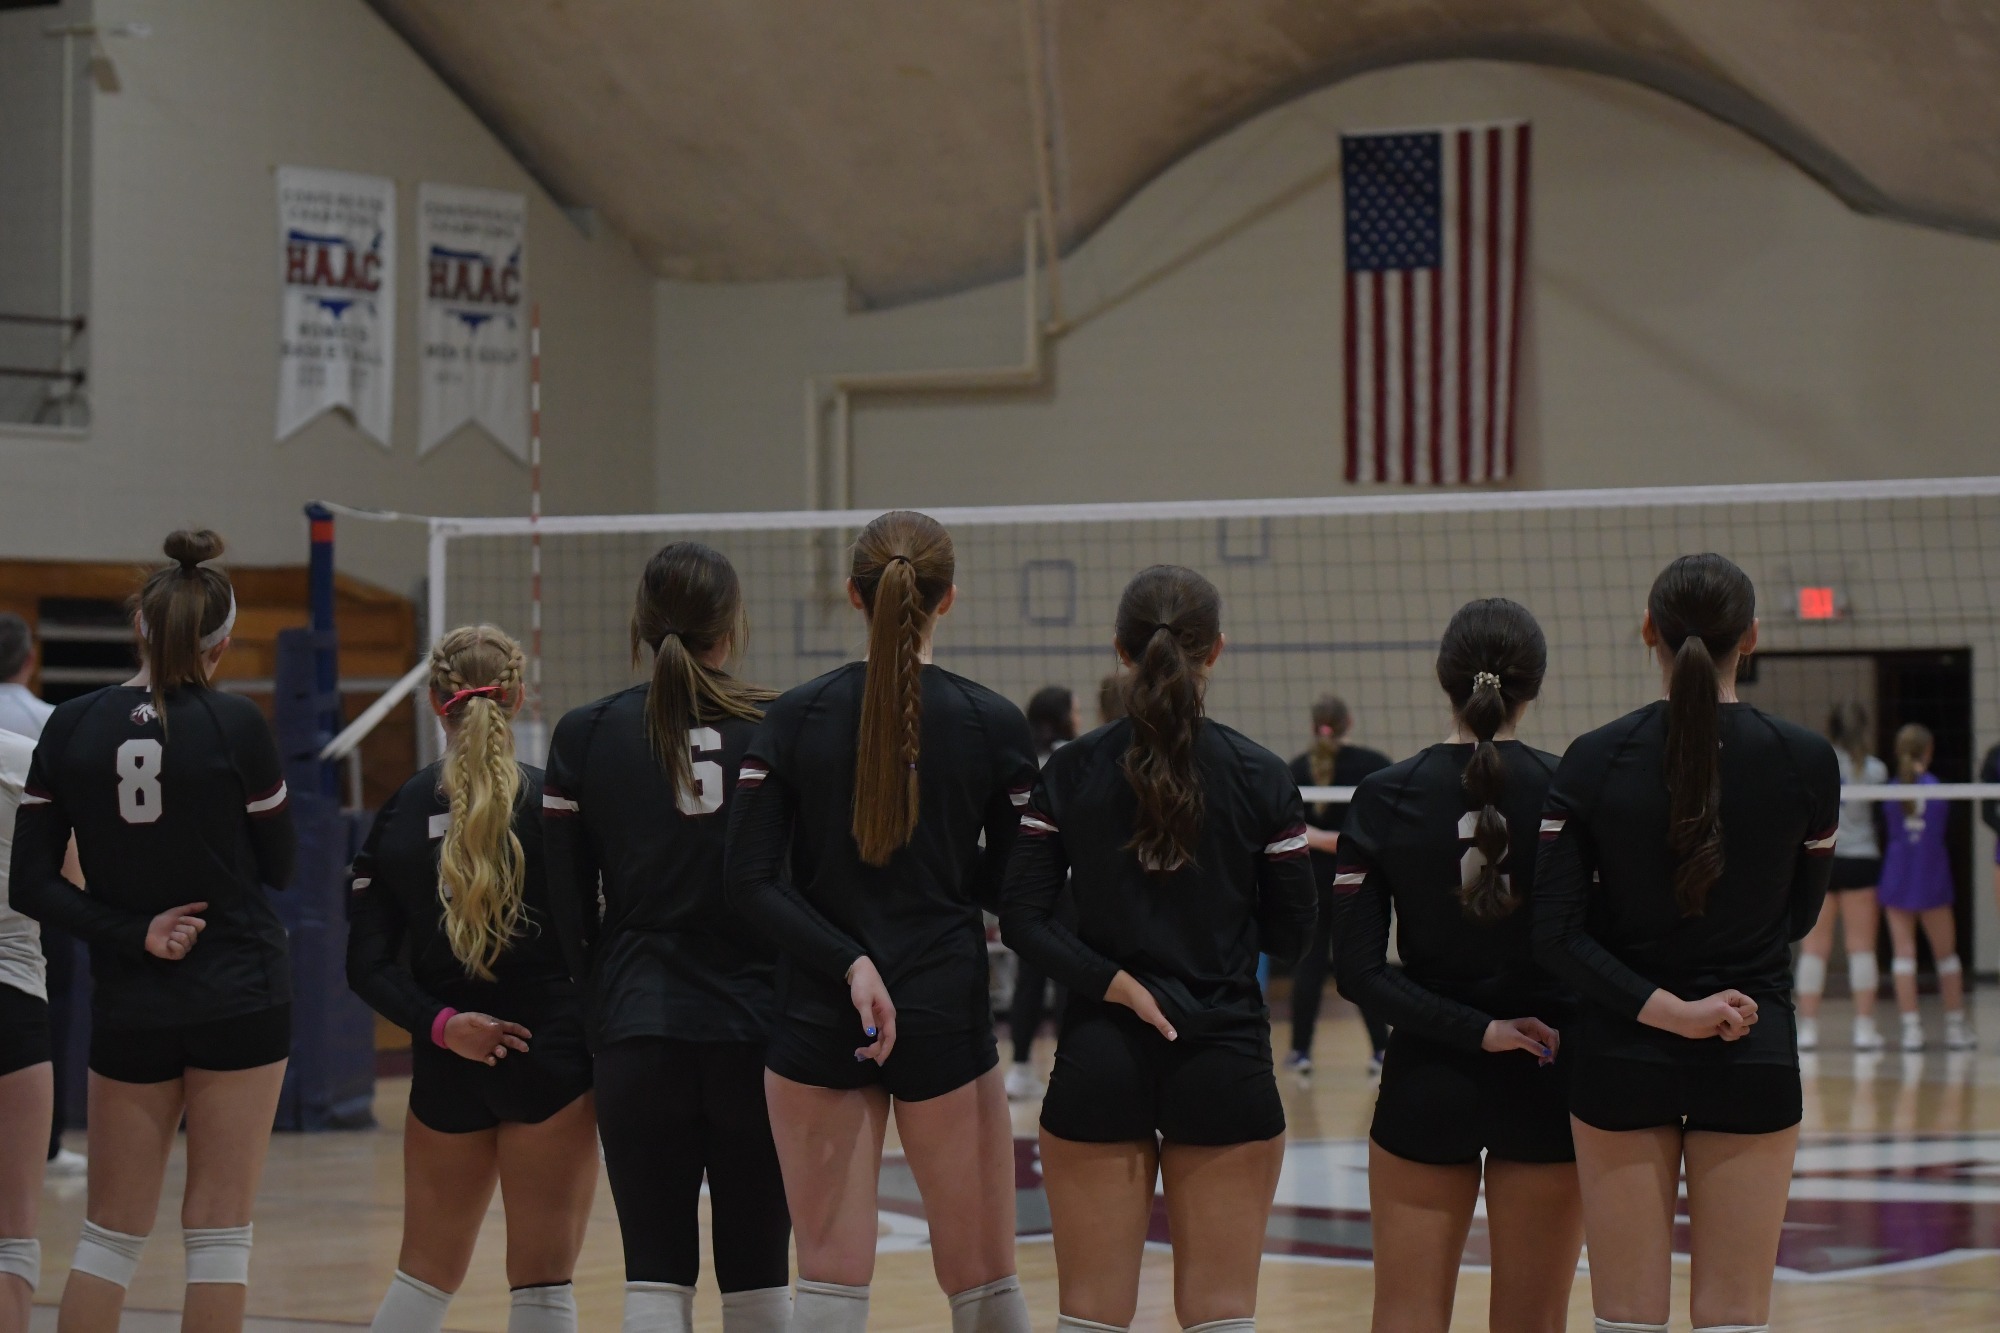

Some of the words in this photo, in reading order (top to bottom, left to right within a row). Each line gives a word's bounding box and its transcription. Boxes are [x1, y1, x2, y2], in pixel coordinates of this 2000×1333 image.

[286, 243, 382, 292] HAAC
[428, 259, 520, 305] HAAC
[116, 738, 163, 824] 8
[676, 726, 724, 816] 6
